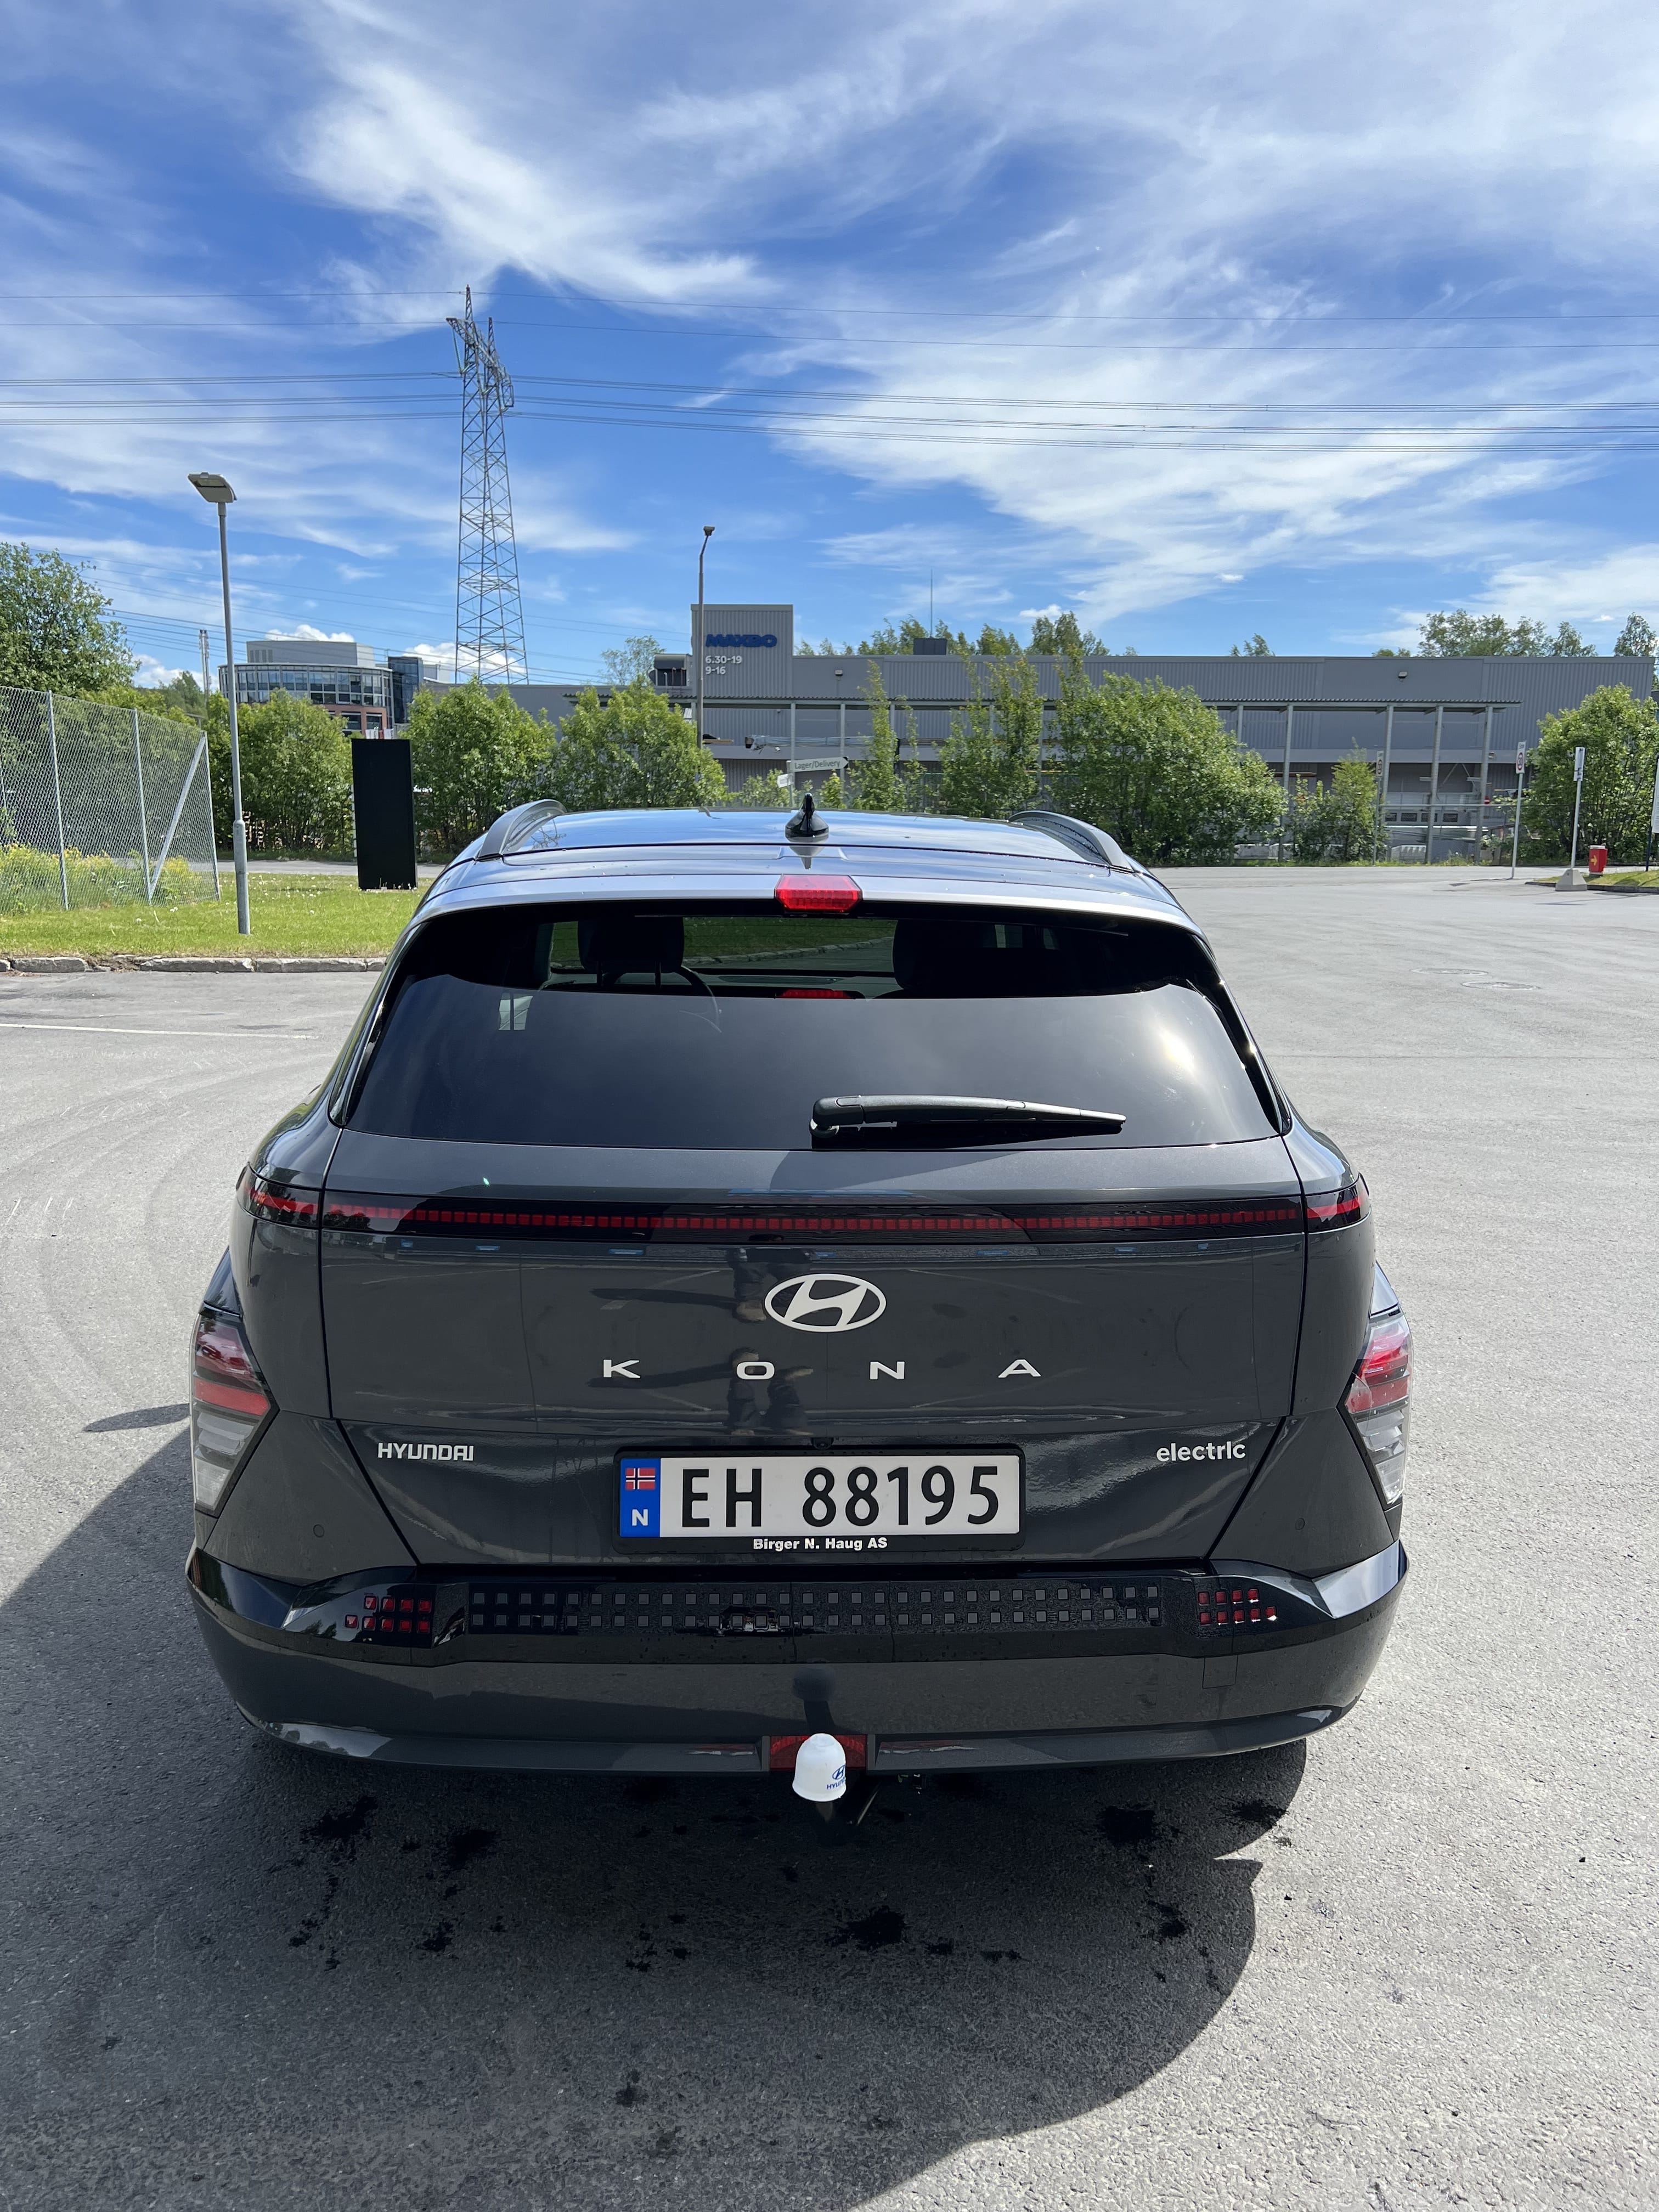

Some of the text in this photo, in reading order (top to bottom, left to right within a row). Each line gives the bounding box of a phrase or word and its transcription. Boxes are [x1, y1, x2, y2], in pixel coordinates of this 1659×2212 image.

[706, 634, 777, 647] MAXBO
[705, 655, 742, 664] 6.30-19
[705, 666, 726, 675] 9-16
[794, 760, 840, 770] Lager/Delivery
[602, 1358, 1041, 1380] KONA
[377, 1442, 474, 1461] HYUNDAI
[1156, 1441, 1246, 1462] electric
[682, 1465, 999, 1527] EH 88195
[631, 1509, 648, 1526] N
[753, 1537, 888, 1552] Birger N. Haug AS
